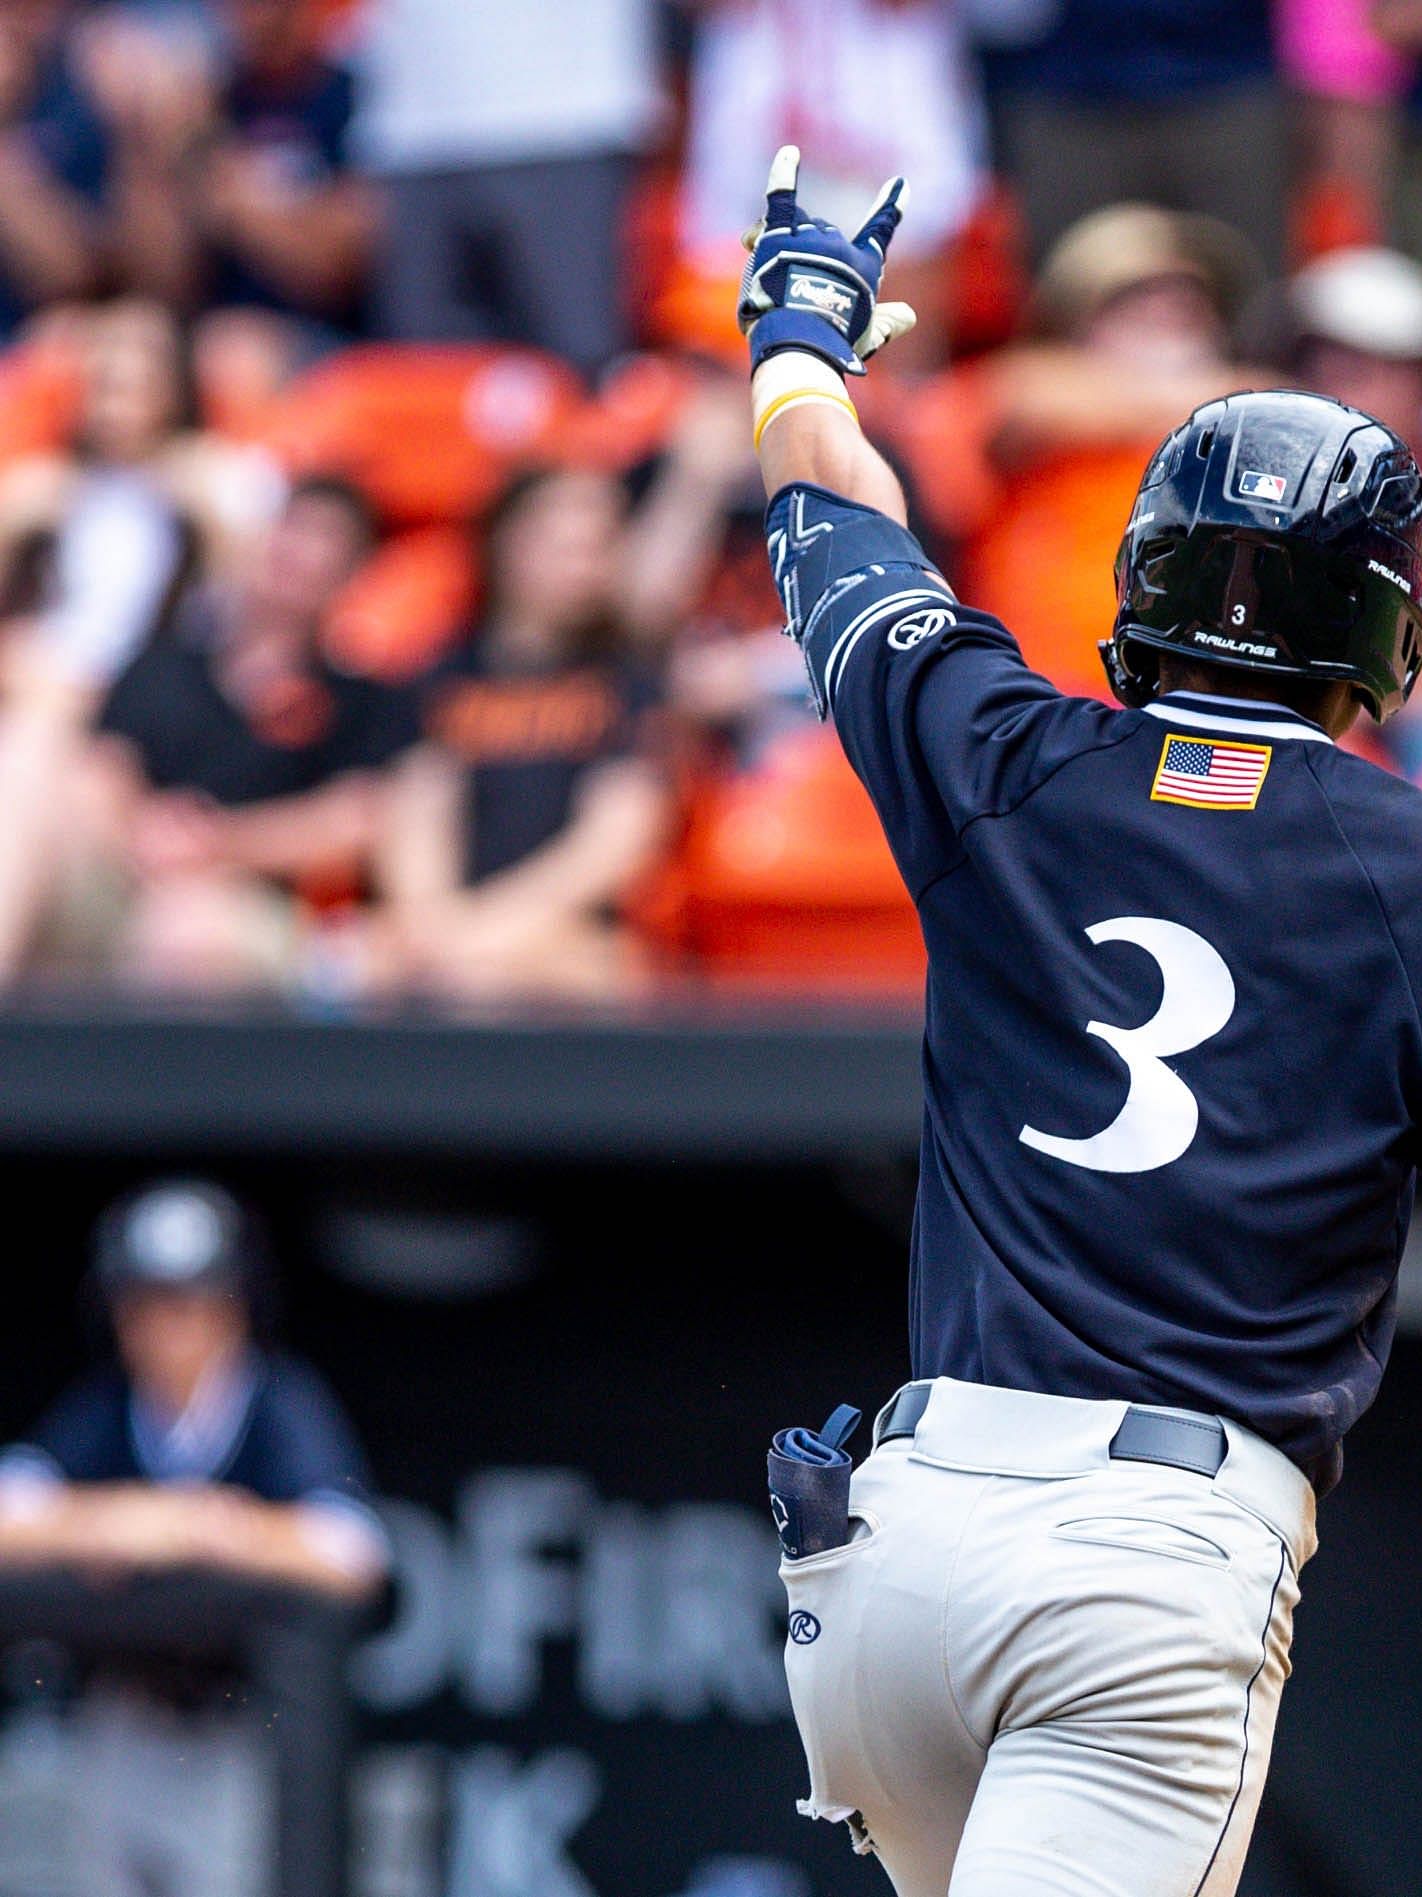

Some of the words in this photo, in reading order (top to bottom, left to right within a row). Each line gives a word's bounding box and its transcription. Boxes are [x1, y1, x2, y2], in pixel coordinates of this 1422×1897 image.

[1231, 604, 1246, 625] 3
[1193, 631, 1278, 658] RAWLINGS
[1019, 916, 1236, 1173] 3
